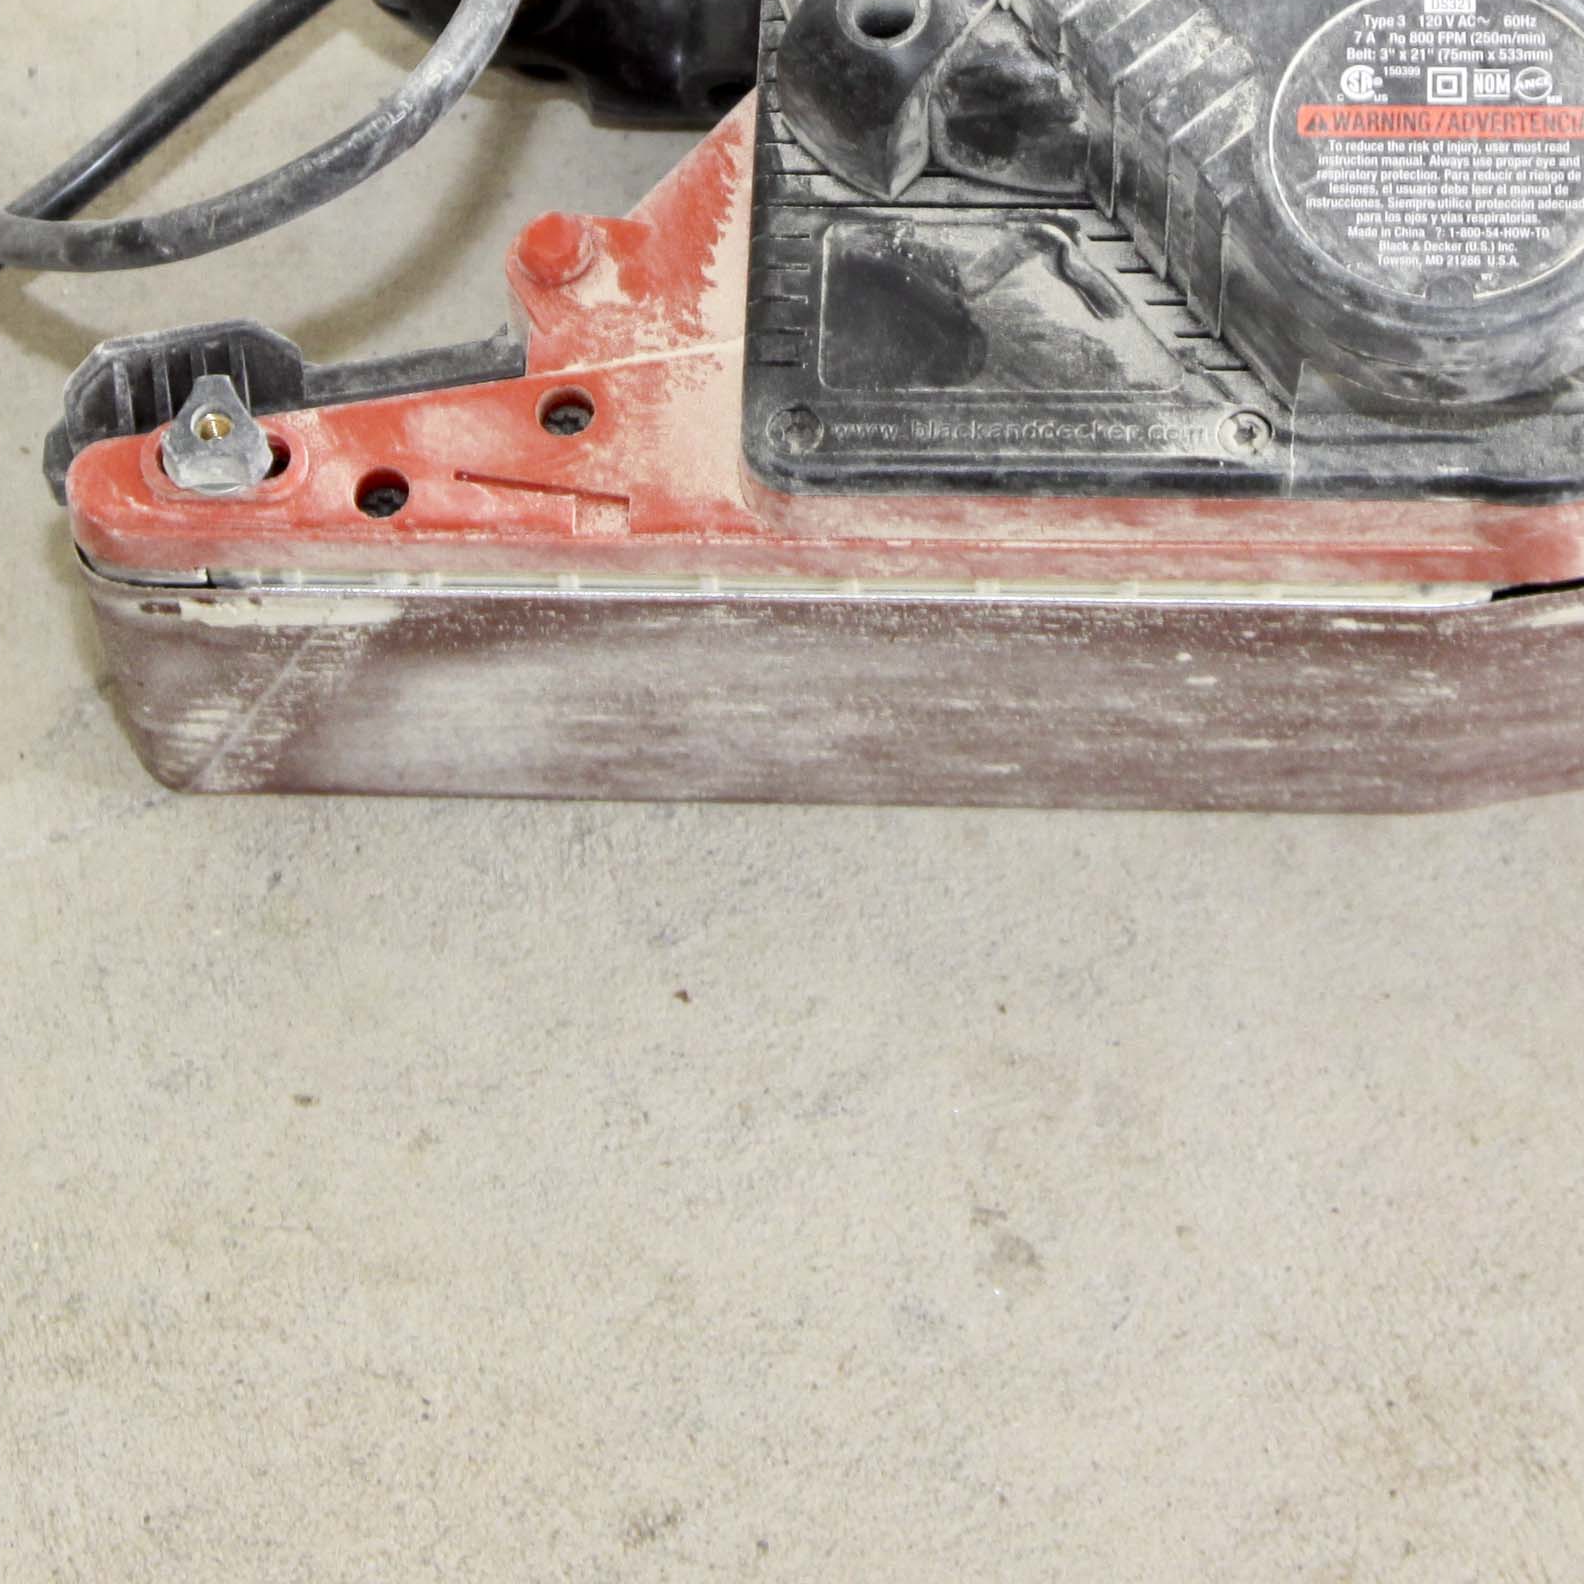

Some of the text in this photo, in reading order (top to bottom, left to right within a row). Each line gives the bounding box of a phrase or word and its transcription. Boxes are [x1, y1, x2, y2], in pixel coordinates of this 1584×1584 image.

[1363, 15, 1396, 29] Type
[1397, 15, 1406, 27] 3
[1419, 15, 1443, 27] 120
[1445, 15, 1455, 27] V
[1503, 15, 1537, 27] 60Hz
[1354, 32, 1363, 44] 7
[1366, 32, 1376, 44] A
[1409, 32, 1435, 44] 800
[1438, 32, 1466, 44] FPM
[1470, 32, 1546, 46] (250m/min)
[1346, 48, 1553, 63] Belt: 3" x 21" (75mm x 533mm)
[1384, 66, 1421, 77] 150399
[1473, 72, 1511, 94] NOM
[1328, 139, 1570, 155] To reduce the risk of injury, user must read
[1318, 154, 1581, 169] instruction manual. Always use proper eye and
[1316, 169, 1582, 183] respiratory protection. Para reducir el riesgo de
[1328, 183, 1569, 195] lesiones, el usuario debe leer el manual de
[1387, 196, 1436, 211] Siempre
[1437, 197, 1472, 209] utilice
[1356, 212, 1382, 224] para
[1384, 211, 1401, 222] los
[1404, 212, 1428, 224] ojos
[1430, 212, 1438, 225] y
[1347, 226, 1378, 238] Made
[1381, 226, 1391, 238] in
[1394, 226, 1426, 238] China
[1379, 240, 1518, 254] Black & Decker (U.S.) Inc.
[1425, 254, 1443, 266] MD
[1446, 254, 1481, 266] 21286
[1487, 254, 1520, 266] U.S.A.
[832, 419, 1209, 444] www.blackanddecker.com
